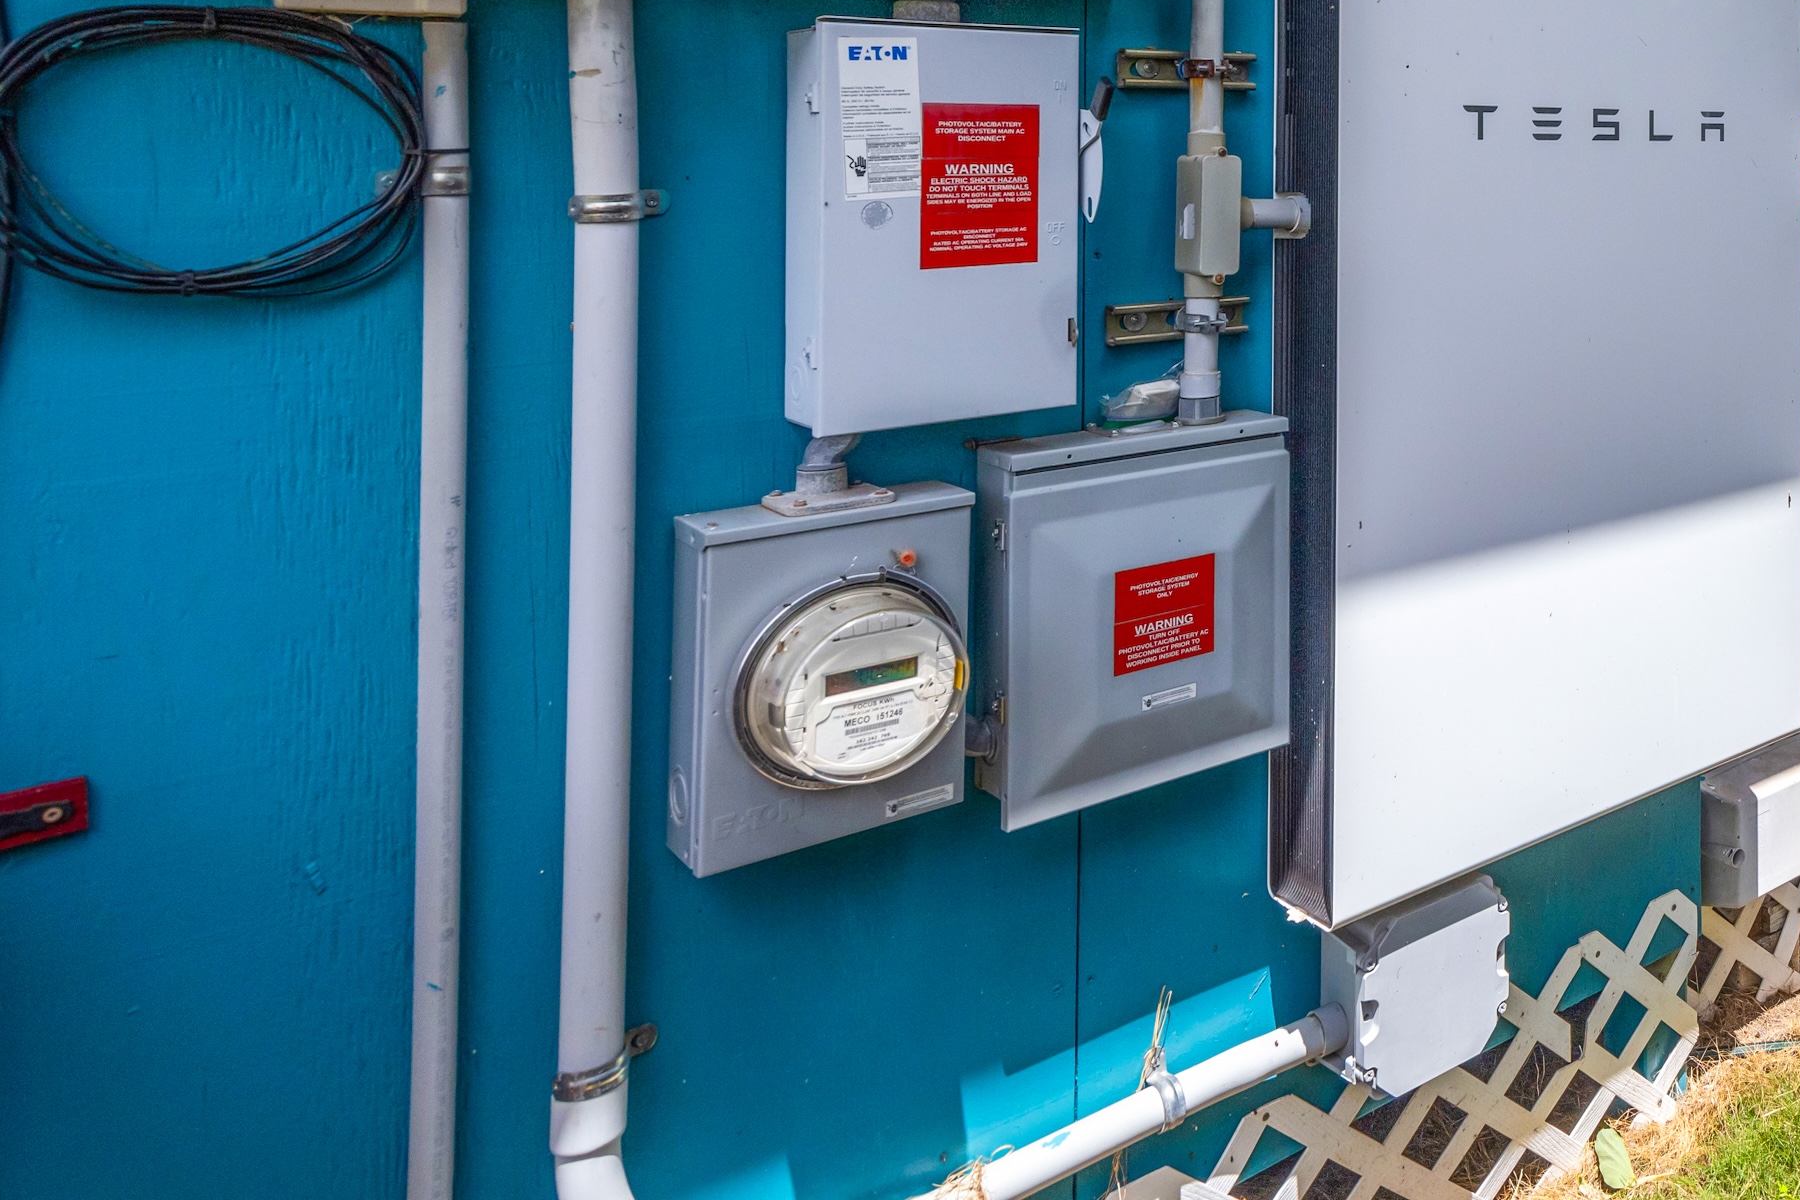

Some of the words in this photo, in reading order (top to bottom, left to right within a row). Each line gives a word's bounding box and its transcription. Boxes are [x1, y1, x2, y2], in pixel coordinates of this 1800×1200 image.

[848, 46, 907, 61] EATON
[1054, 80, 1067, 91] ON
[1462, 104, 1725, 142] TESLA
[945, 163, 1014, 175] WARNING
[1046, 222, 1065, 234] OFF
[1130, 573, 1198, 591] PHOTOVOLTAIC/ENERGY
[1138, 586, 1166, 596] STORAGE
[1167, 581, 1190, 590] SYSTEM
[1135, 614, 1193, 635] WARNING
[1149, 631, 1167, 640] TURN
[1168, 628, 1180, 636] OFF
[1119, 631, 1198, 655] PHOTOVOLTAIC/BATTERY
[1128, 645, 1169, 660] DISCONNECT
[1171, 640, 1190, 650] PRIOR
[1126, 657, 1157, 668] WORKING
[1159, 650, 1179, 659] INSIDE
[1181, 645, 1201, 655] PANEL
[853, 700, 878, 710] FOCUS
[844, 715, 871, 728] MECO
[711, 795, 805, 842] EATON
